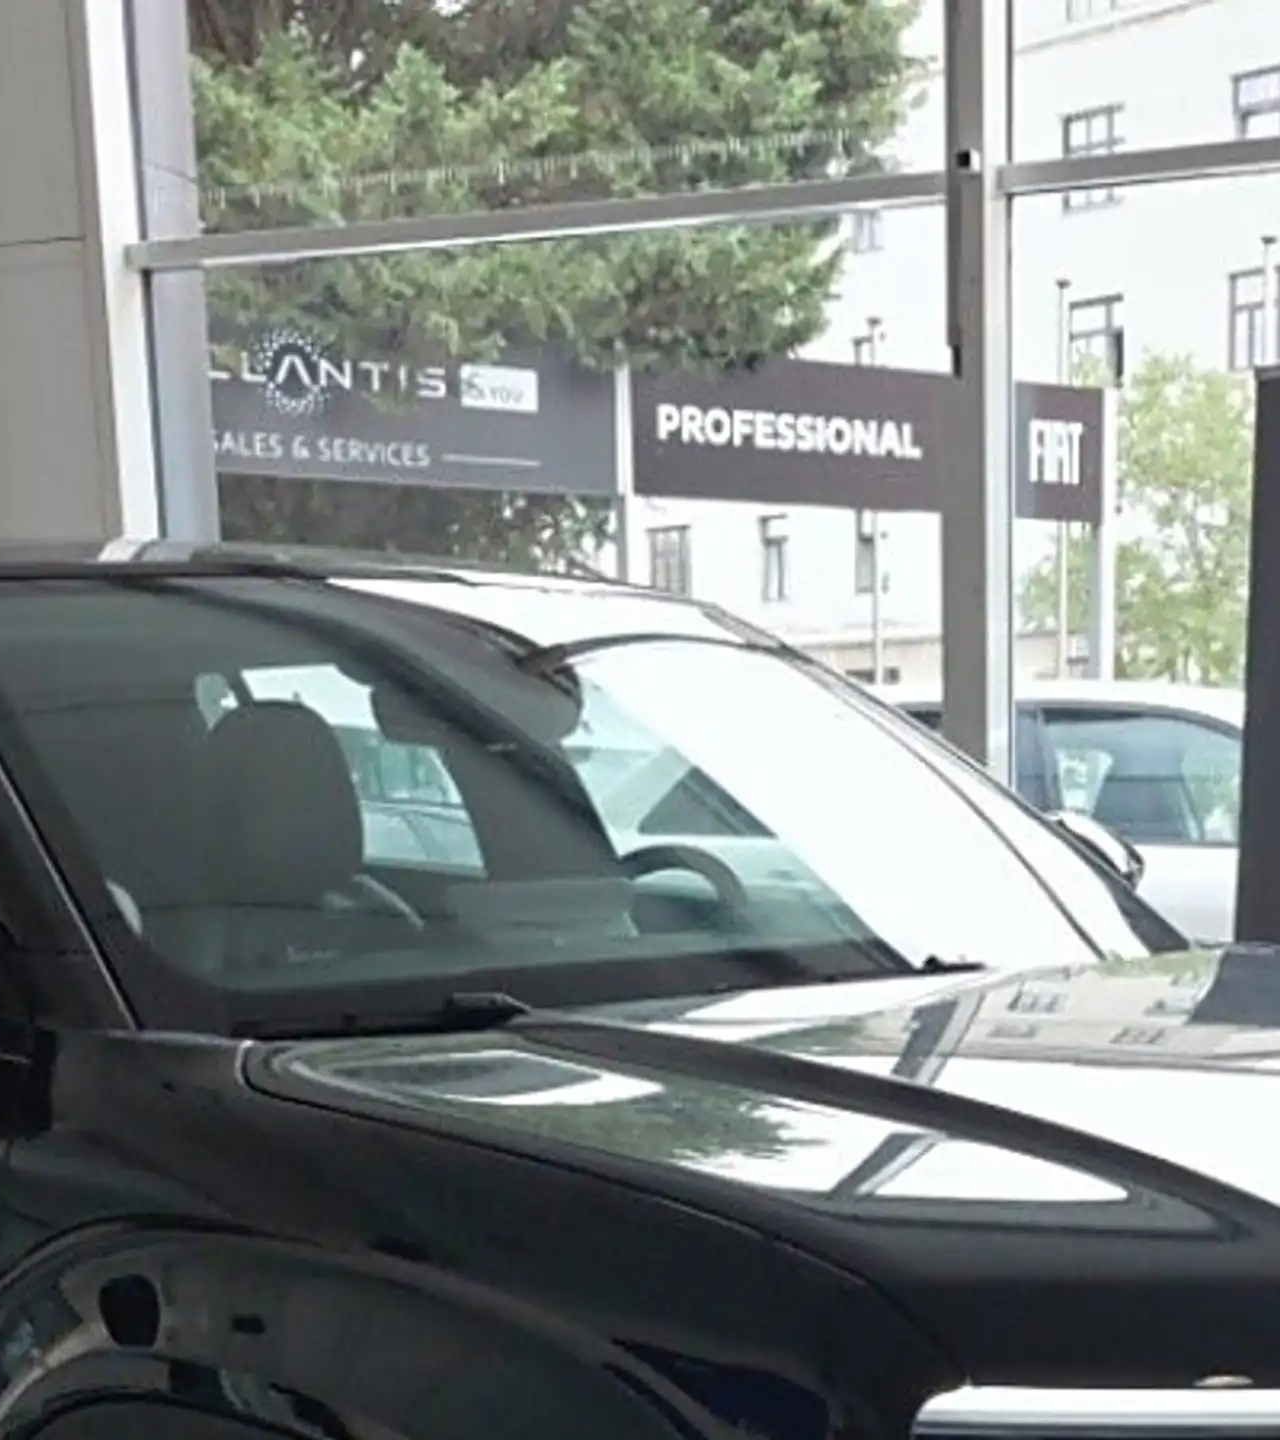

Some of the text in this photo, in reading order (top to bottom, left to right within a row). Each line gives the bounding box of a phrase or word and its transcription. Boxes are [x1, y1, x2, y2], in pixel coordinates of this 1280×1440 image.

[317, 436, 431, 467] SERVICES
[656, 404, 922, 459] PROFESSIONAL
[1028, 418, 1083, 485] FIAT
